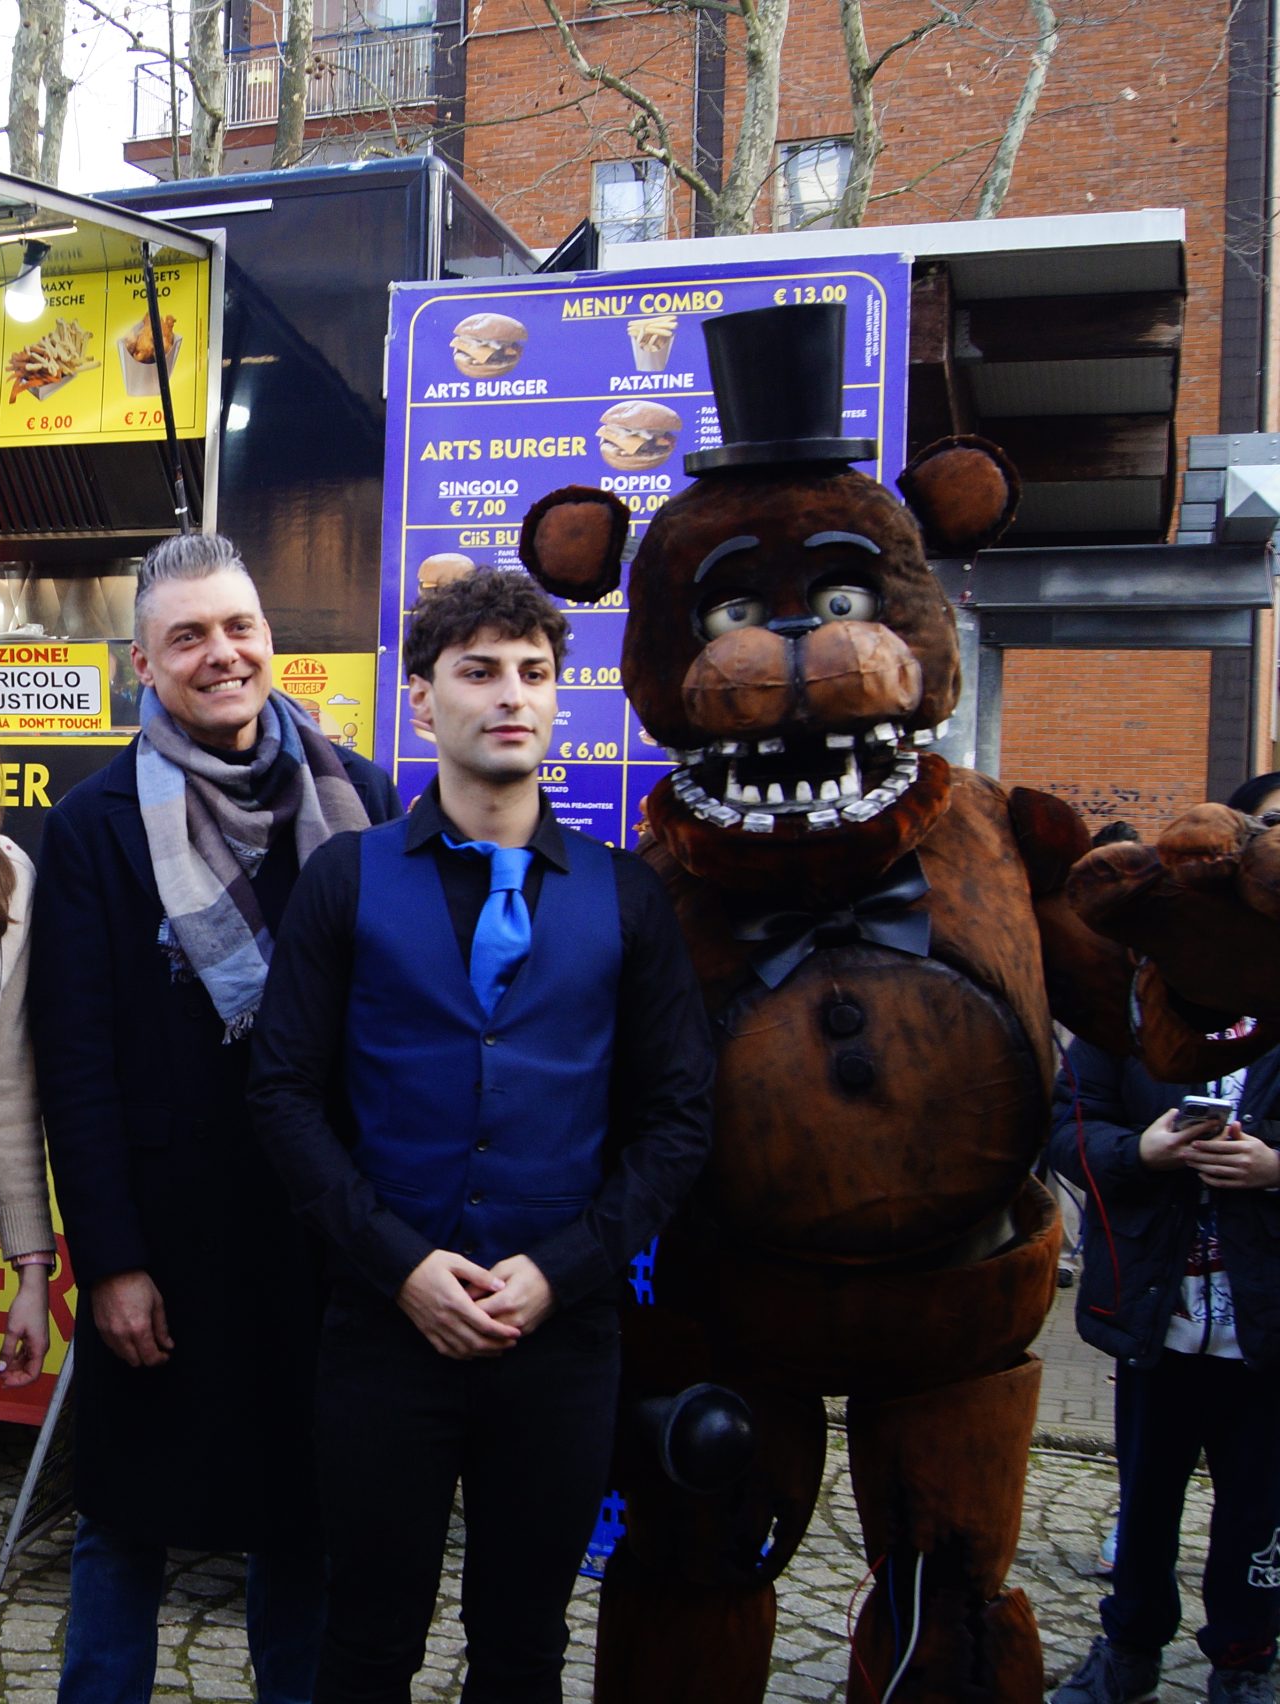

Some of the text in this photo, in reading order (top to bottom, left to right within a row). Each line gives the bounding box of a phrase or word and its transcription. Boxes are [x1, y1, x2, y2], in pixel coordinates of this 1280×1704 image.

[124, 270, 180, 285] NUGETS
[132, 286, 171, 300] POLO
[639, 290, 724, 314] COMBO
[774, 284, 847, 305] € 13,00
[424, 379, 548, 399] ARTS BURGER
[609, 373, 695, 392] PATATINE
[26, 415, 73, 431] € 8,00
[124, 410, 164, 427] € 7,0
[420, 436, 587, 462] ARTS BURGER
[438, 479, 519, 497] SINGOLO
[600, 474, 671, 492] DOPPIO
[450, 499, 506, 518] € 7,00
[459, 530, 490, 546] CiiS
[287, 659, 322, 675] ARTS
[562, 667, 621, 686] € 8,00
[286, 682, 322, 693] BURGER
[19, 717, 55, 729] DON'T
[60, 718, 102, 729] TOUCH!
[560, 741, 618, 761] € 6,00
